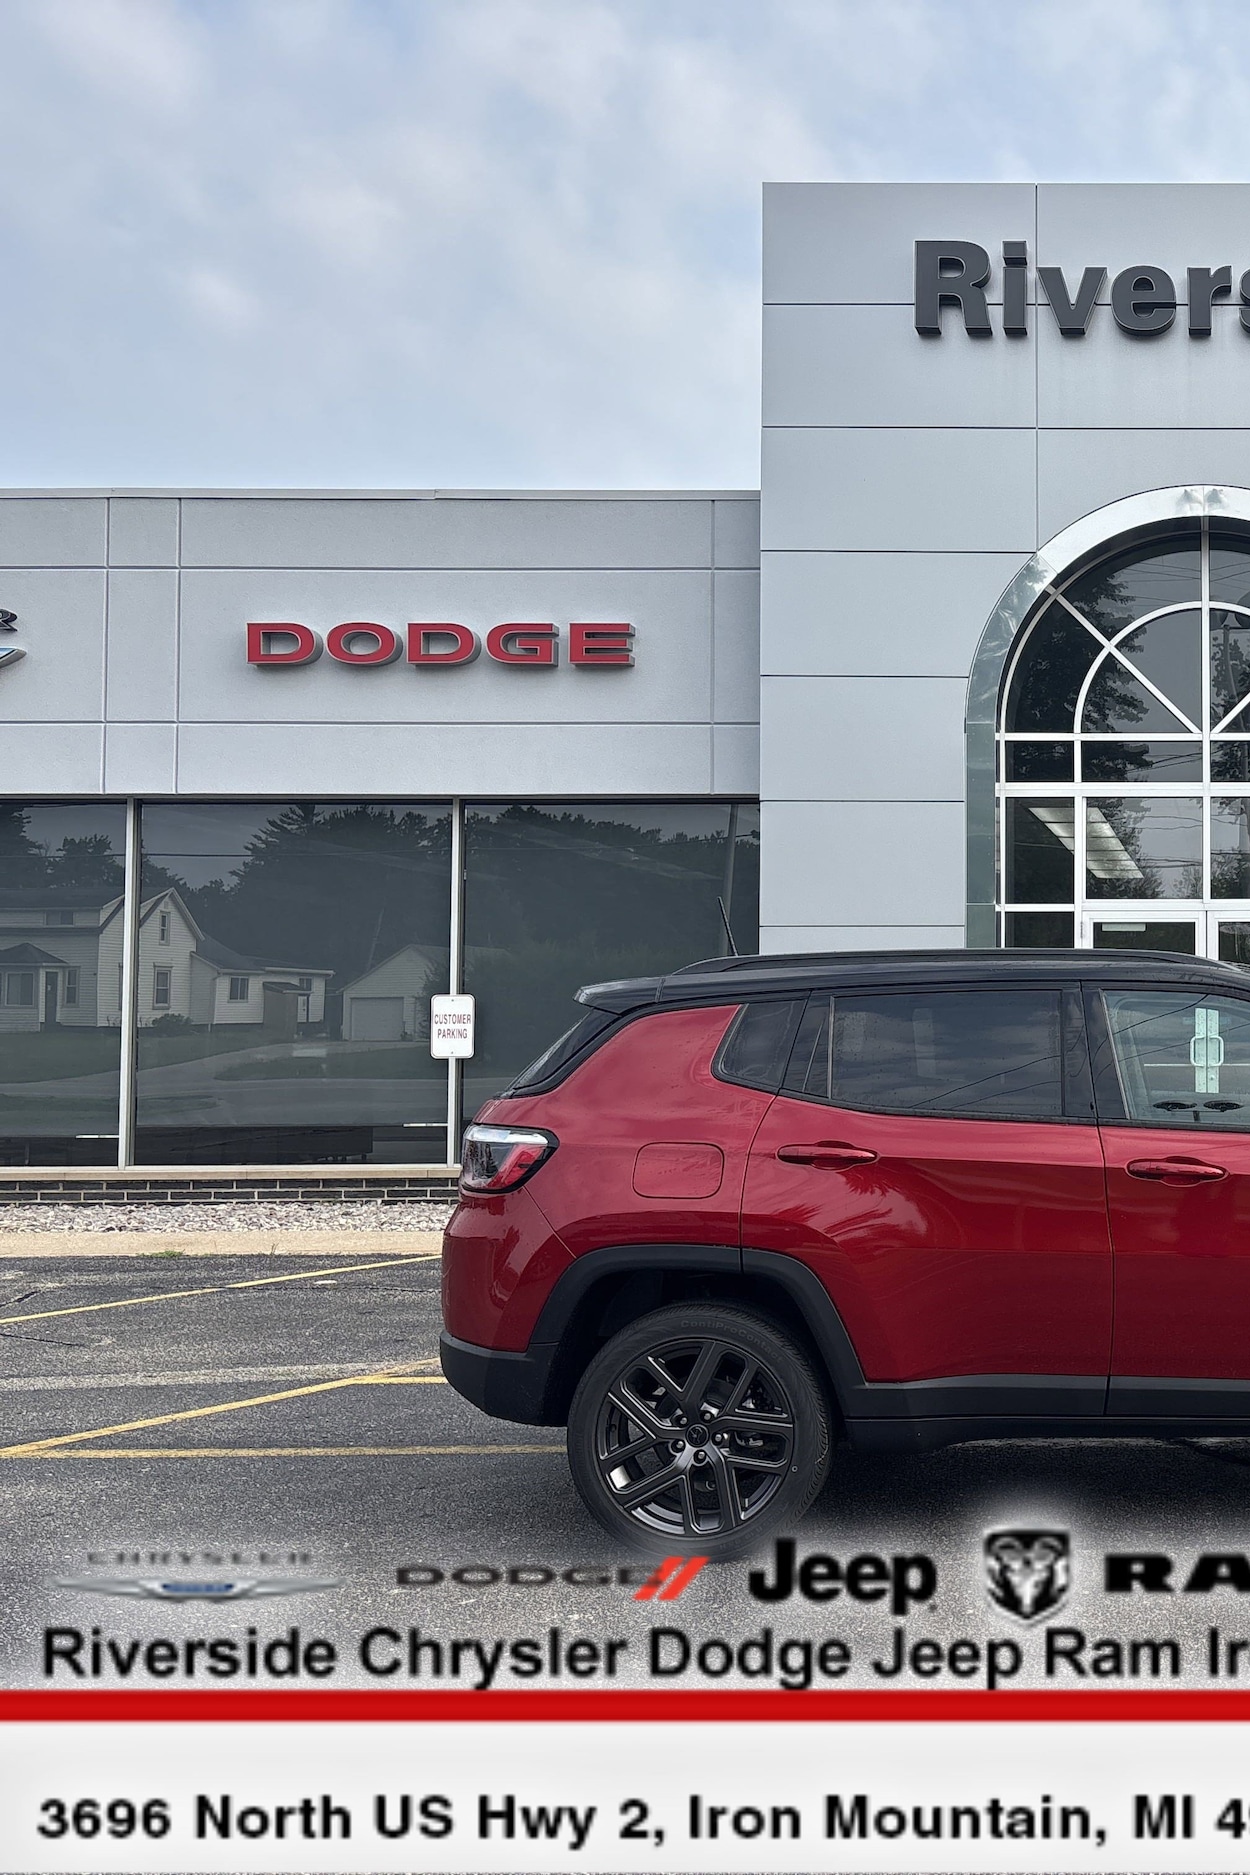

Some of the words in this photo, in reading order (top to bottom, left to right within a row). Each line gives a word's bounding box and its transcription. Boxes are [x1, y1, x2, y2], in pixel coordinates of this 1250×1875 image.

[246, 621, 635, 668] DODGE
[434, 1013, 472, 1025] CUSTOMER
[437, 1028, 468, 1039] PARKING
